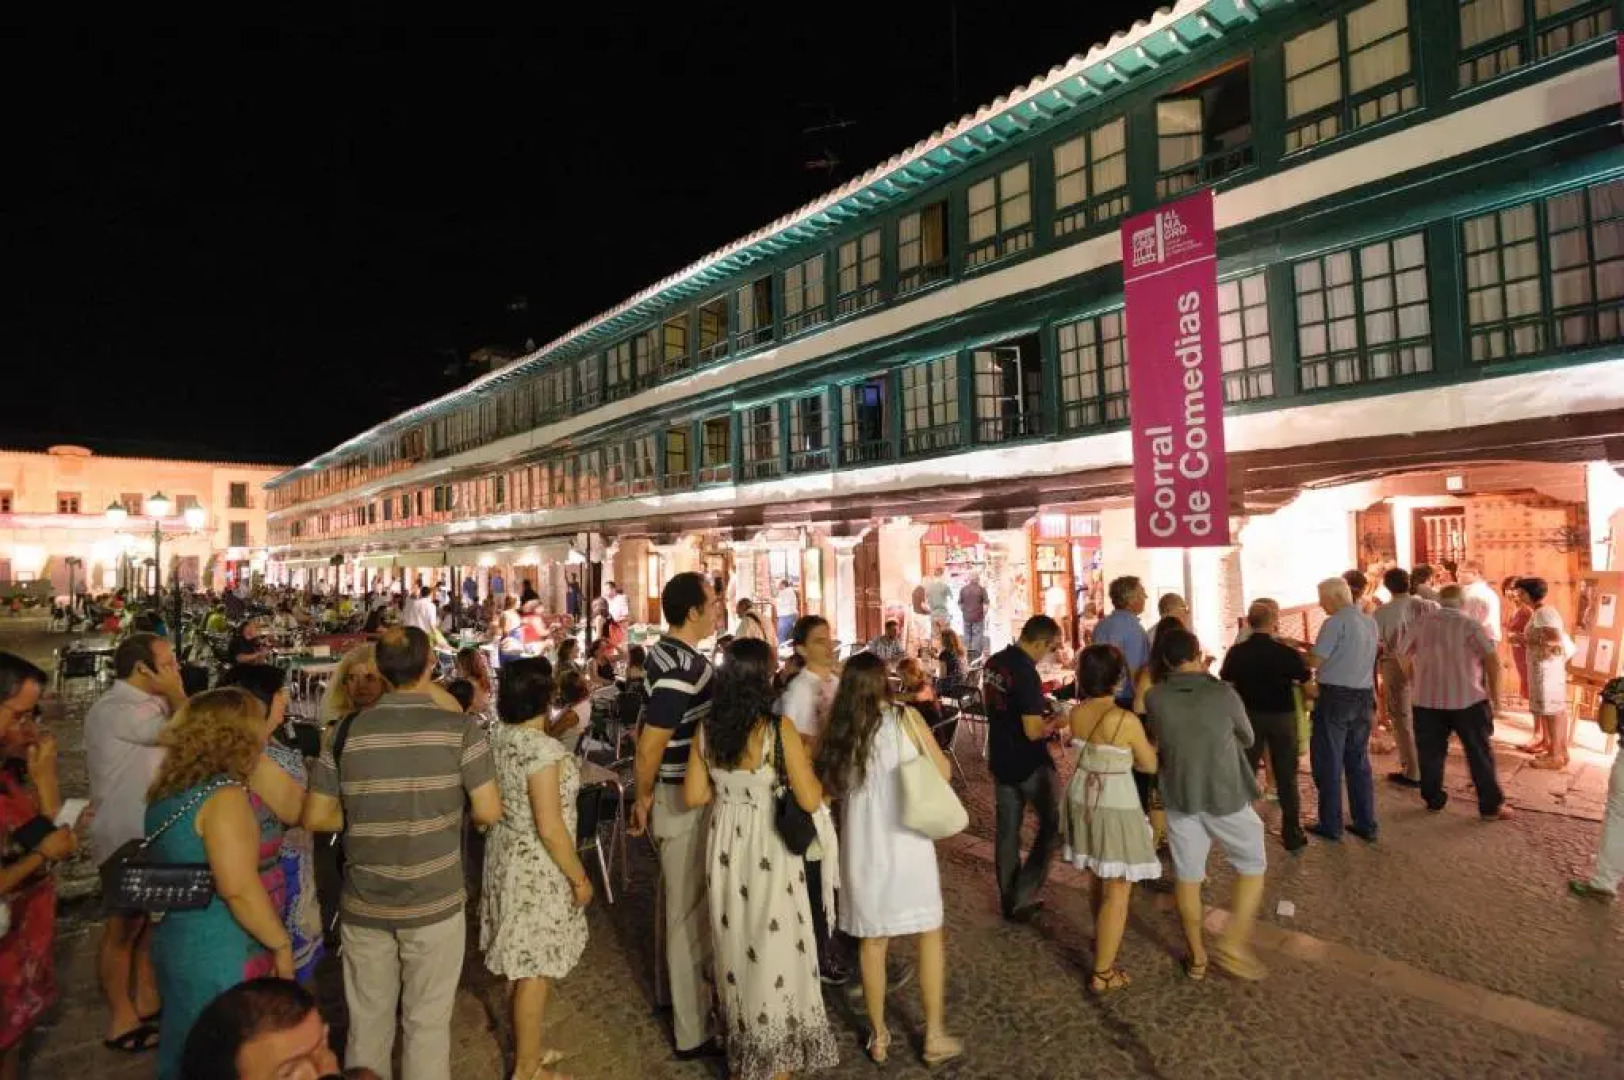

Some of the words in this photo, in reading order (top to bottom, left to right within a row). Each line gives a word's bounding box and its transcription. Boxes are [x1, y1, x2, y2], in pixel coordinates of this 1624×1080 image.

[1164, 208, 1178, 220] AL
[1164, 225, 1187, 240] GRO
[1175, 290, 1210, 480] Comedias
[1145, 425, 1177, 538] Corral
[1183, 489, 1212, 537] de
